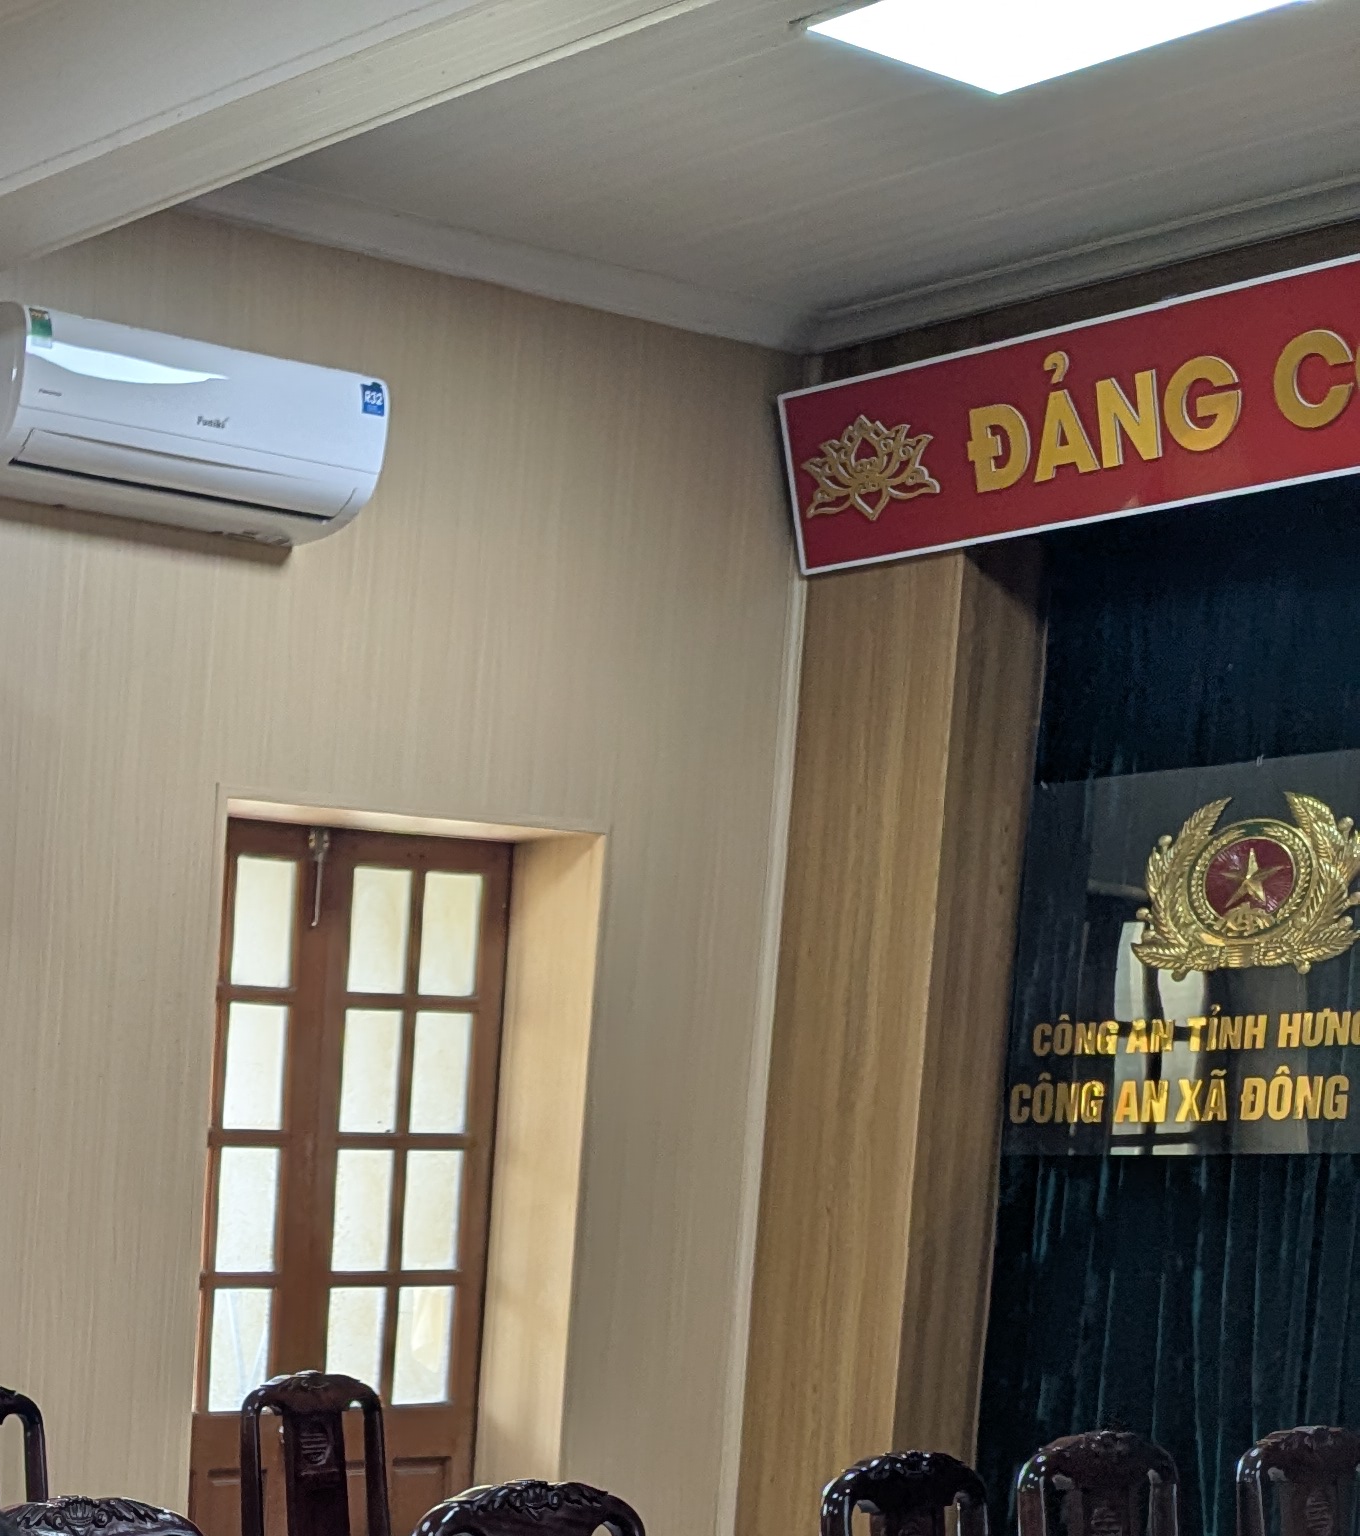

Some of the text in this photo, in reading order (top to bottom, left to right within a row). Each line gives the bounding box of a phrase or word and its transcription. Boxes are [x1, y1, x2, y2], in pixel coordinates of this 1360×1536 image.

[364, 390, 383, 406] R32
[967, 329, 1360, 493] ĐẢNG C
[1033, 1013, 1119, 1057] CÔNG
[1125, 1017, 1176, 1054] AN
[1187, 1003, 1268, 1052] TỈNH
[1009, 1064, 1350, 1124] CÔNG AN XÃ ĐÔNG
